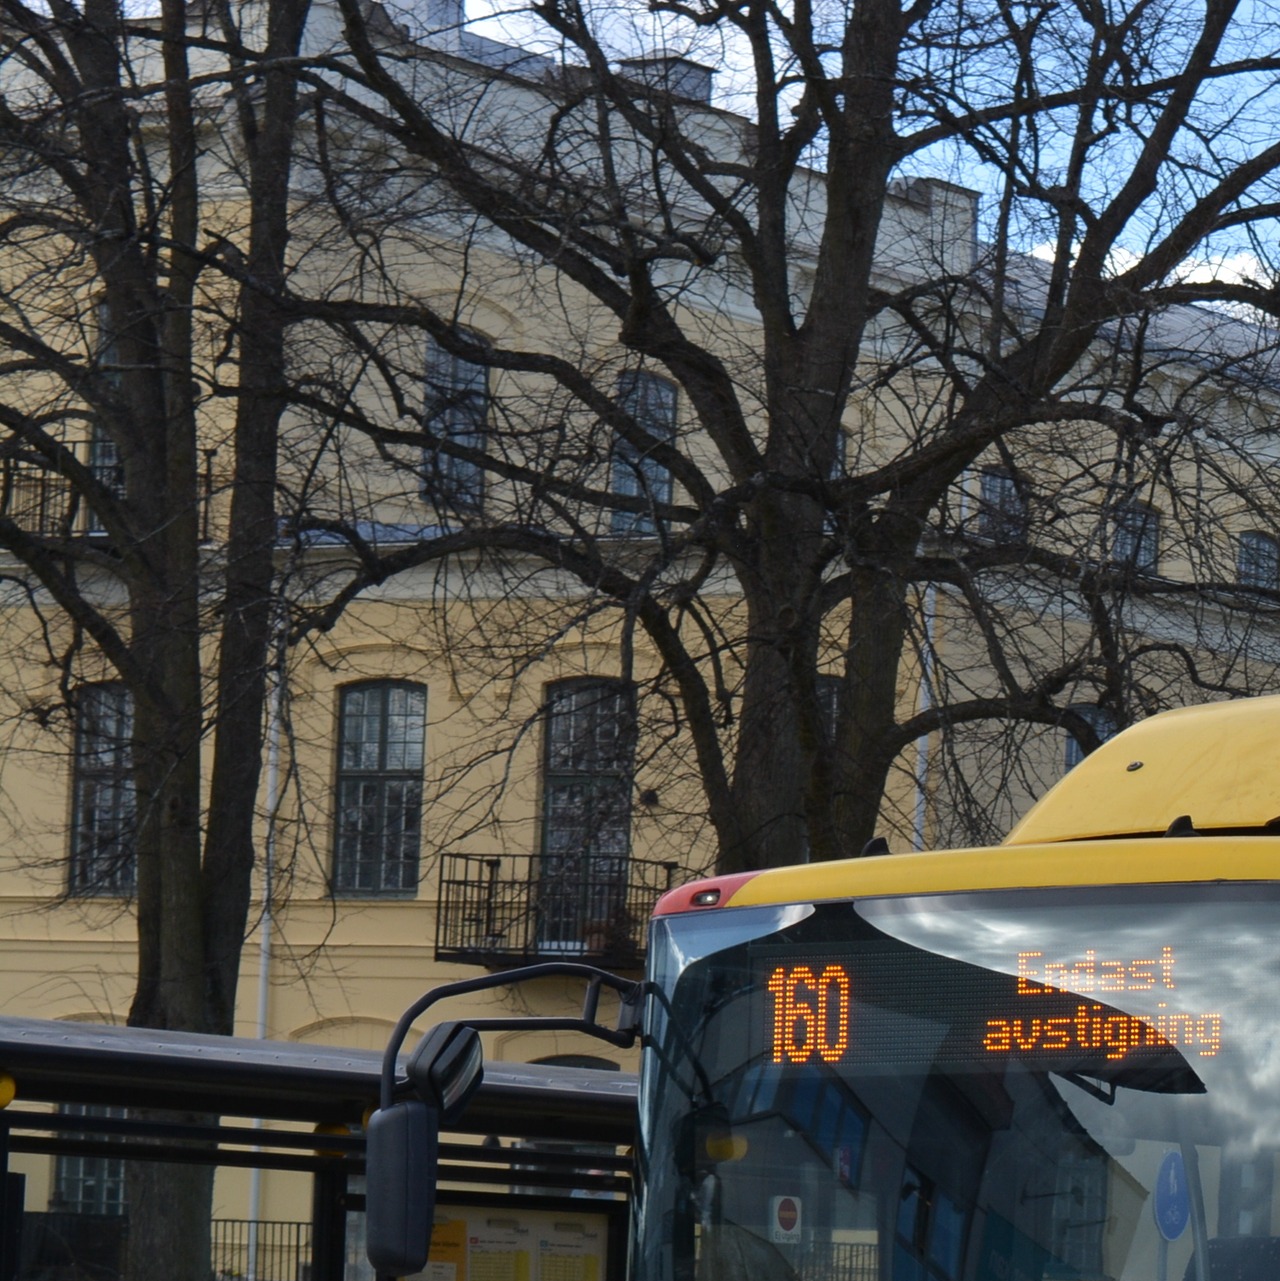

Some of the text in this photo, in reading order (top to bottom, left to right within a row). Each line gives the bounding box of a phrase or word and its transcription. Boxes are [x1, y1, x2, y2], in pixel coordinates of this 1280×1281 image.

[1018, 946, 1175, 995] Endast
[768, 965, 850, 1063] 160
[982, 1002, 1221, 1060] avstigning
